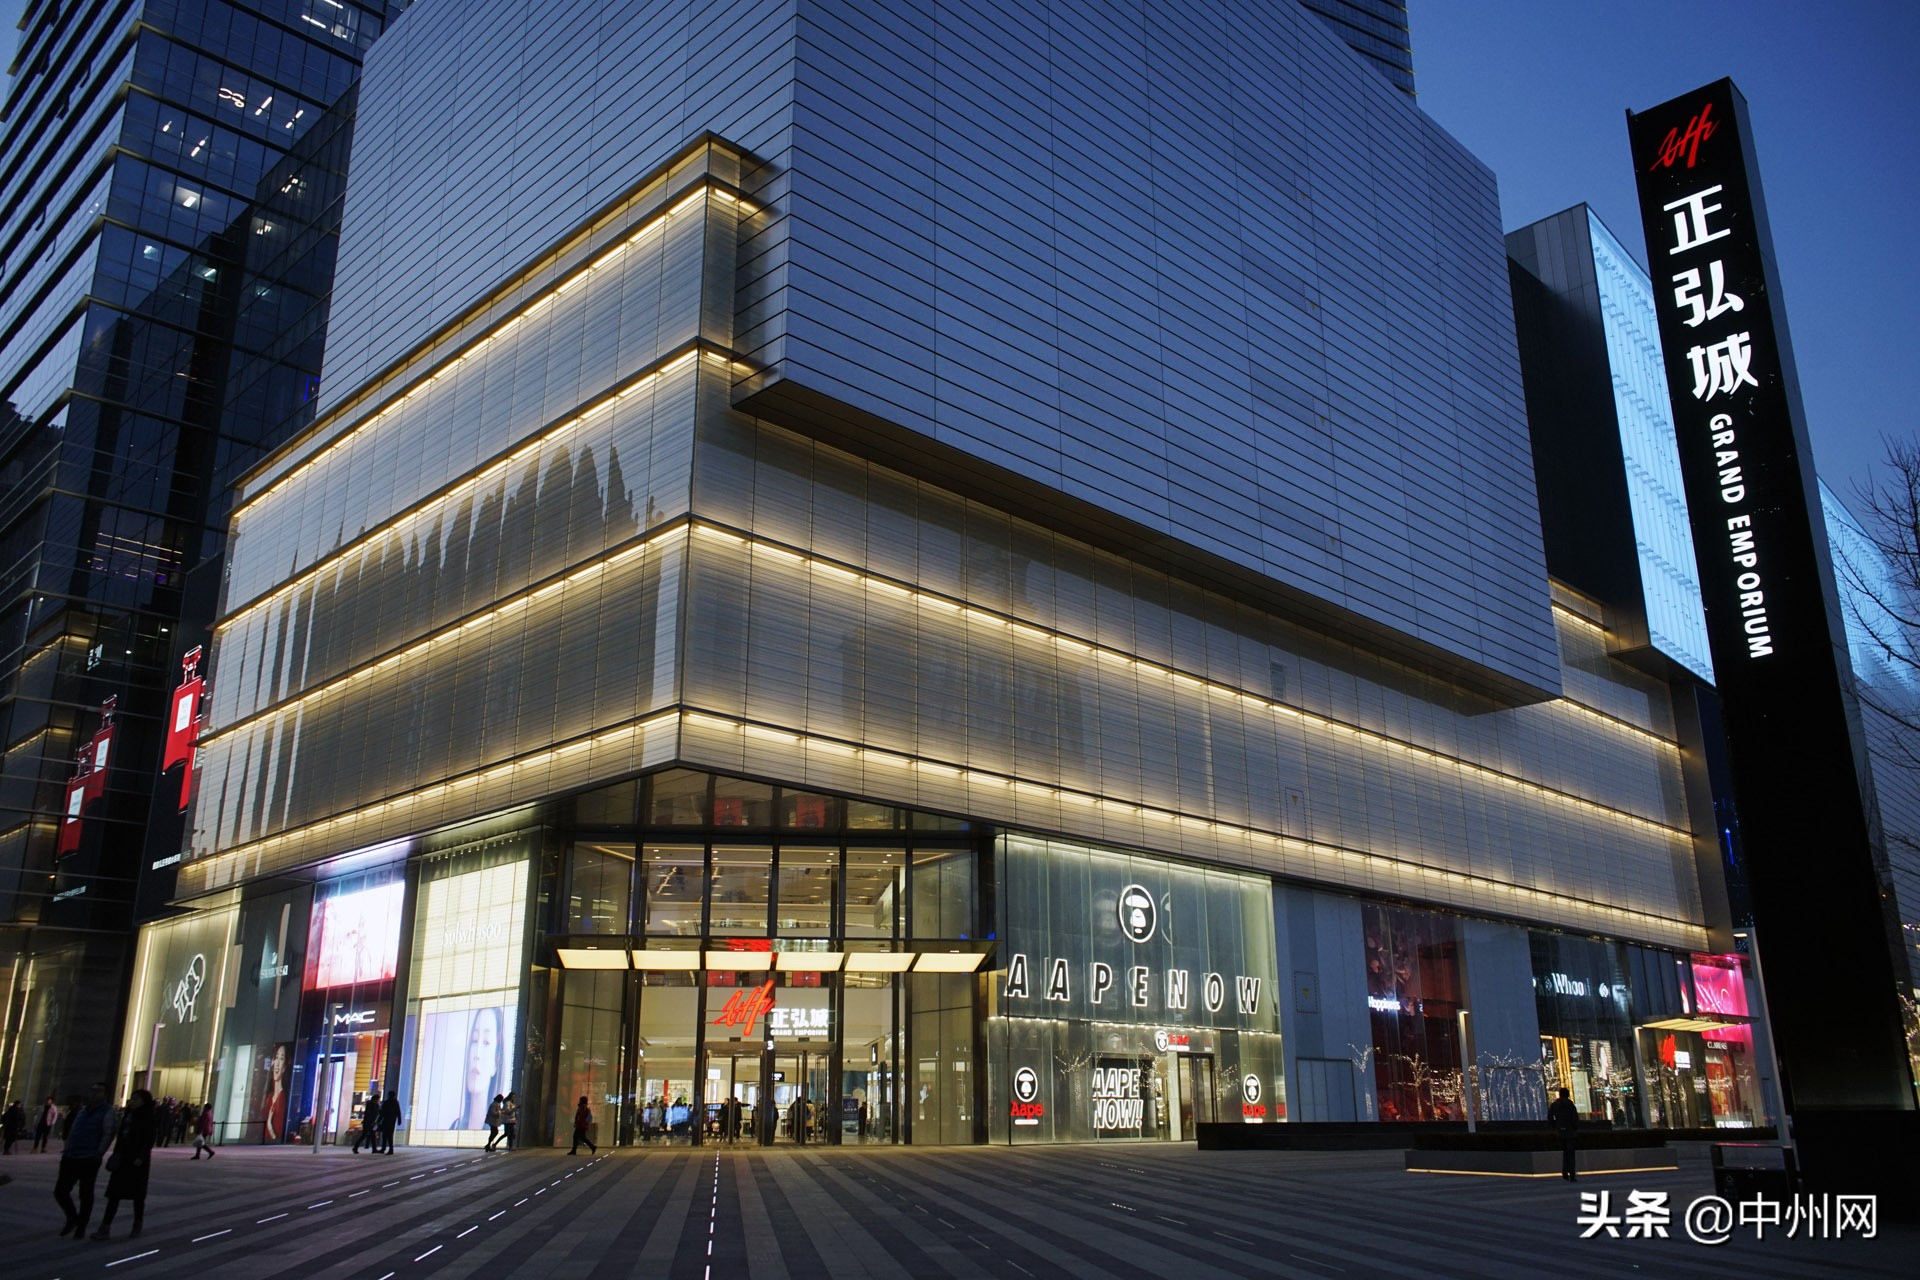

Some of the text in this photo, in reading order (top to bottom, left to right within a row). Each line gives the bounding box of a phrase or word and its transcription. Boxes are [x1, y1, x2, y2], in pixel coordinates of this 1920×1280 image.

[1663, 184, 1759, 402] 正弘城
[1709, 413, 1773, 658] GRAND EMPORIUM
[770, 1008, 829, 1028] 正弘城
[1092, 1067, 1142, 1098] AAPE
[1010, 1101, 1043, 1119] Aape
[1093, 1098, 1144, 1129] NOW!
